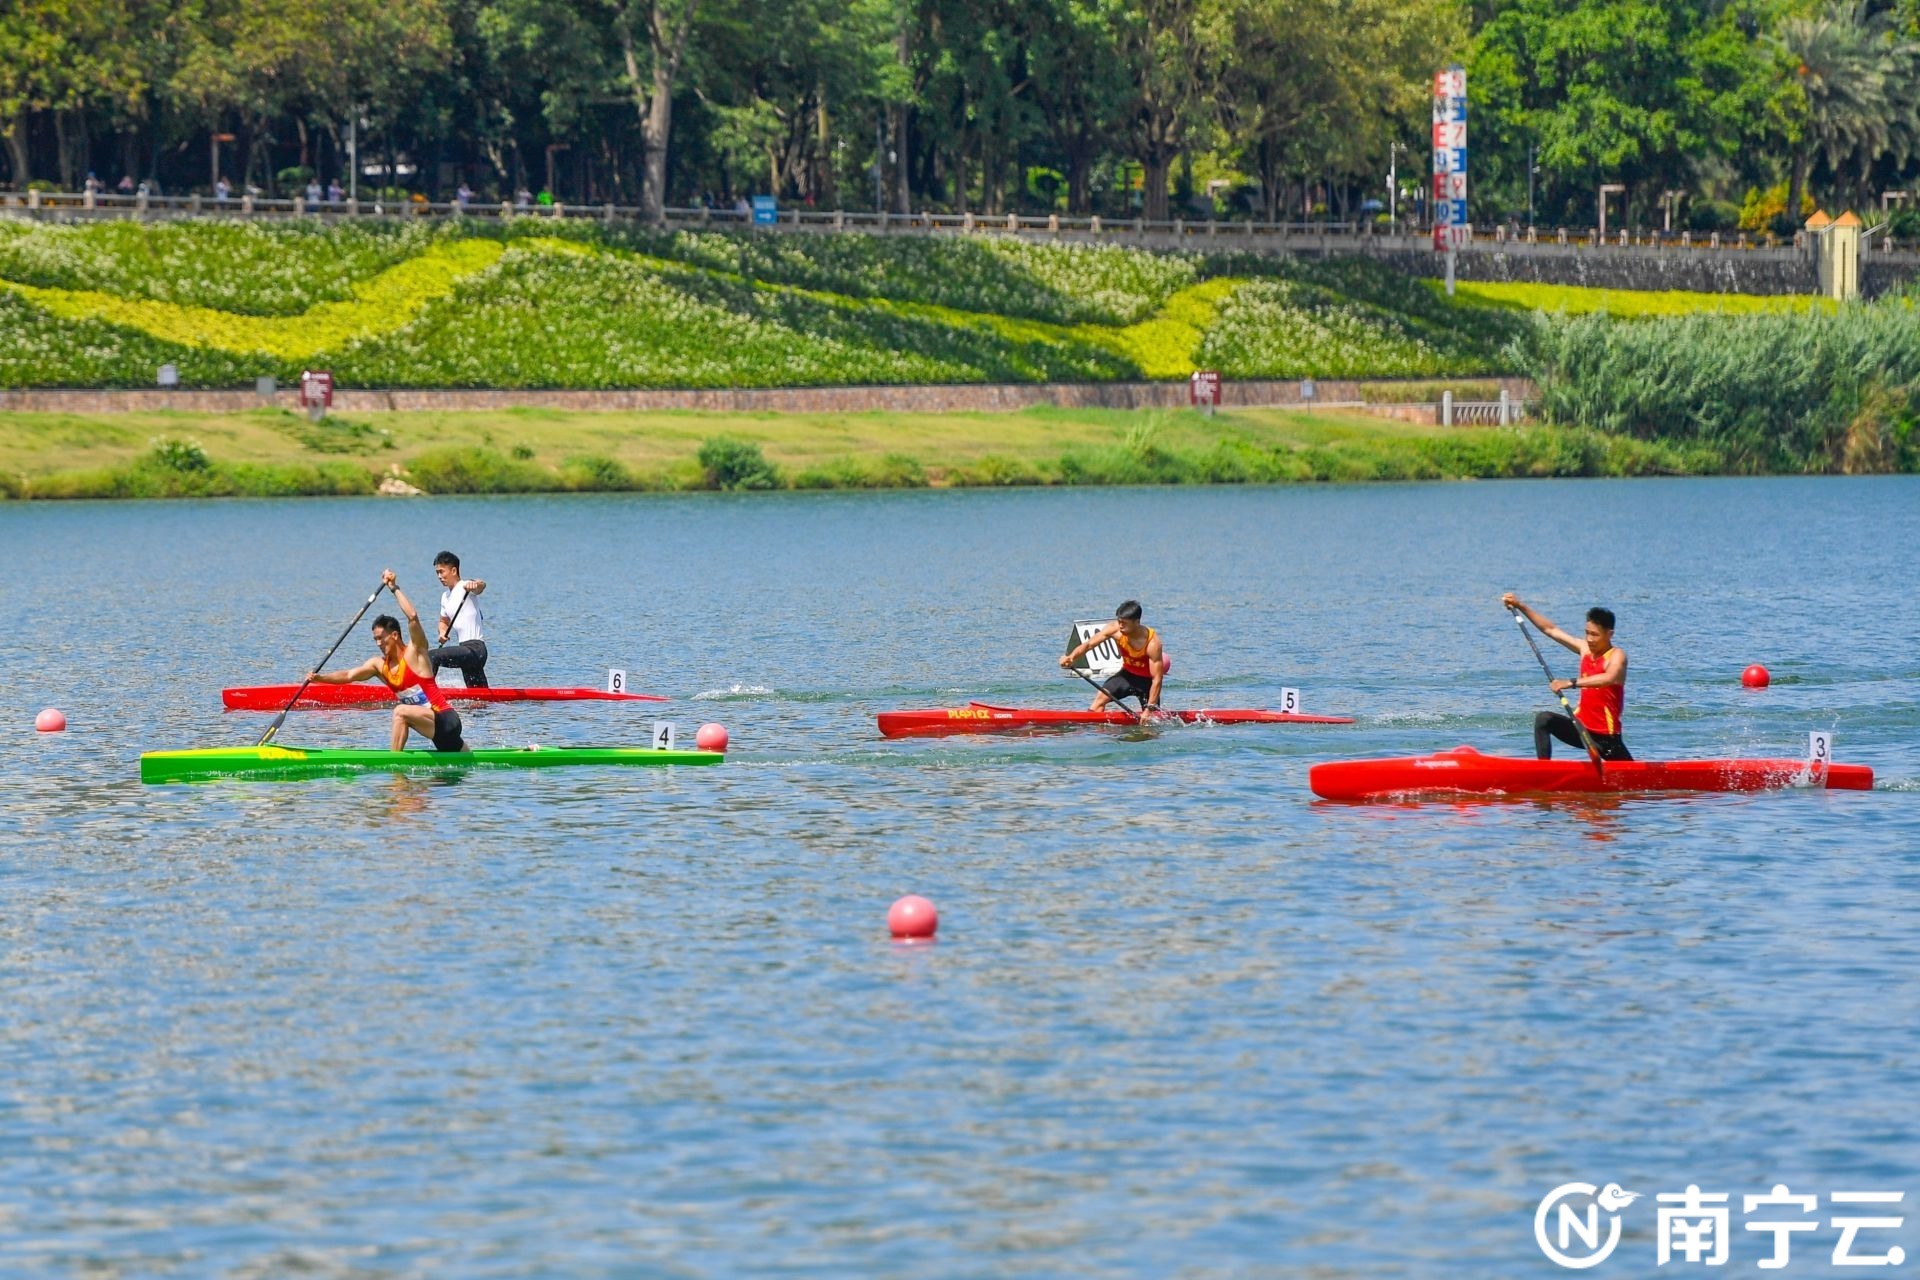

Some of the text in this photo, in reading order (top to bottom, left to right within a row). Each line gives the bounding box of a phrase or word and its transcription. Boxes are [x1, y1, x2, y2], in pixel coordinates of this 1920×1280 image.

[613, 673, 622, 689] 6
[1286, 692, 1294, 709] 5
[658, 726, 670, 746] 4
[1816, 736, 1826, 758] 3
